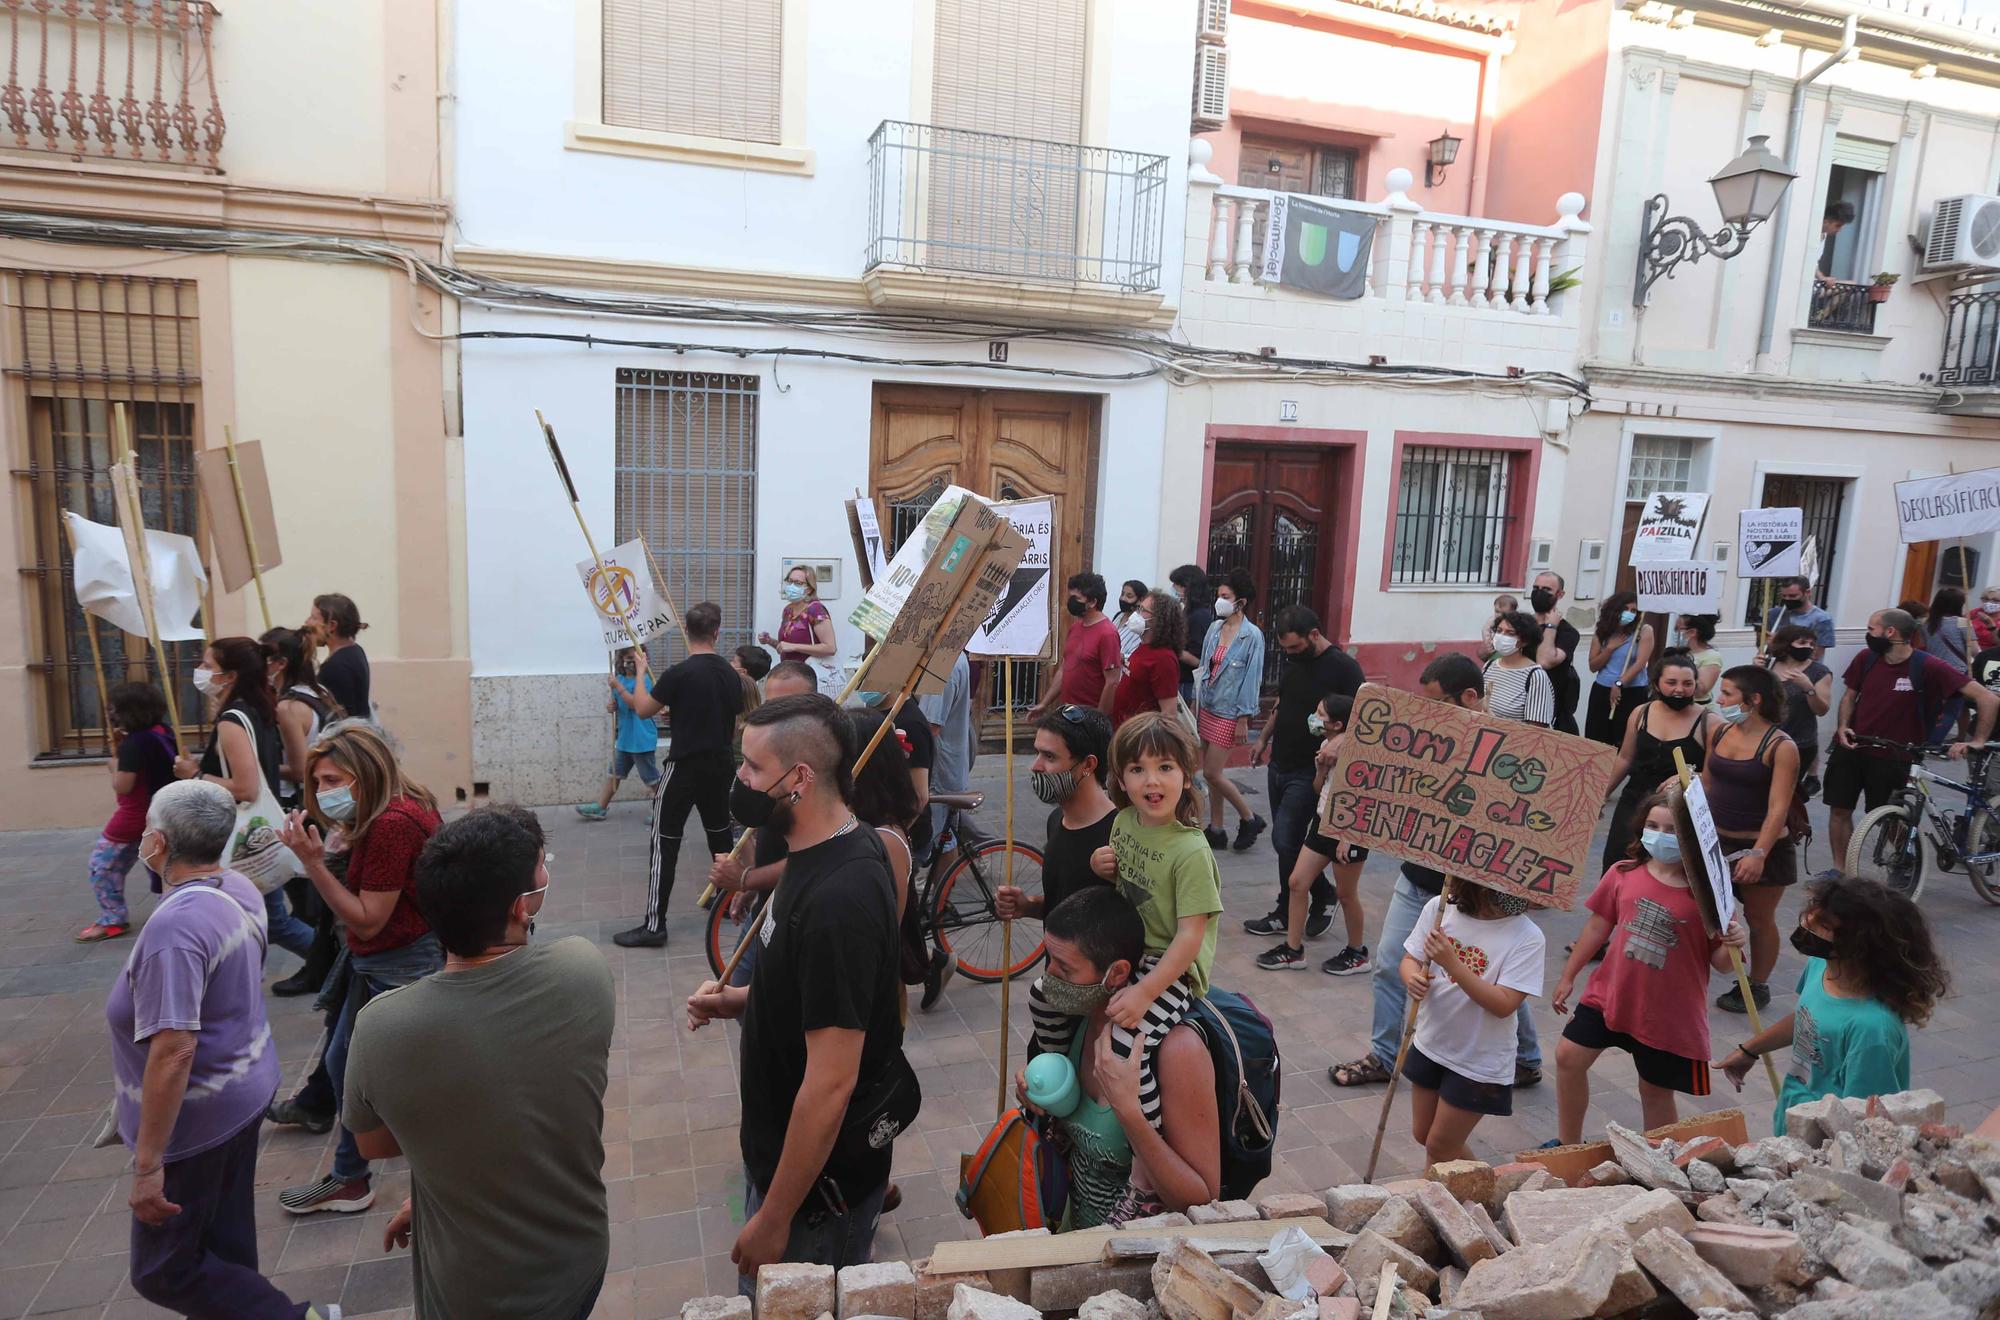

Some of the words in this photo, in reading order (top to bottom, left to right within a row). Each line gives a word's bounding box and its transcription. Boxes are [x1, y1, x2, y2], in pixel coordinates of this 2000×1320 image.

[1266, 196, 1285, 277] Benimaclet
[991, 343, 1006, 360] 14
[1283, 403, 1297, 418] 12
[1640, 526, 1691, 540] PAIZILLA
[1020, 553, 1048, 565] ARRIS
[583, 559, 616, 588] CUIDM
[888, 564, 911, 588] NO
[647, 613, 671, 632] PAI
[1355, 699, 1455, 764] Som
[1464, 728, 1547, 794] les
[1346, 760, 1476, 816] arrels
[1486, 796, 1556, 832] de
